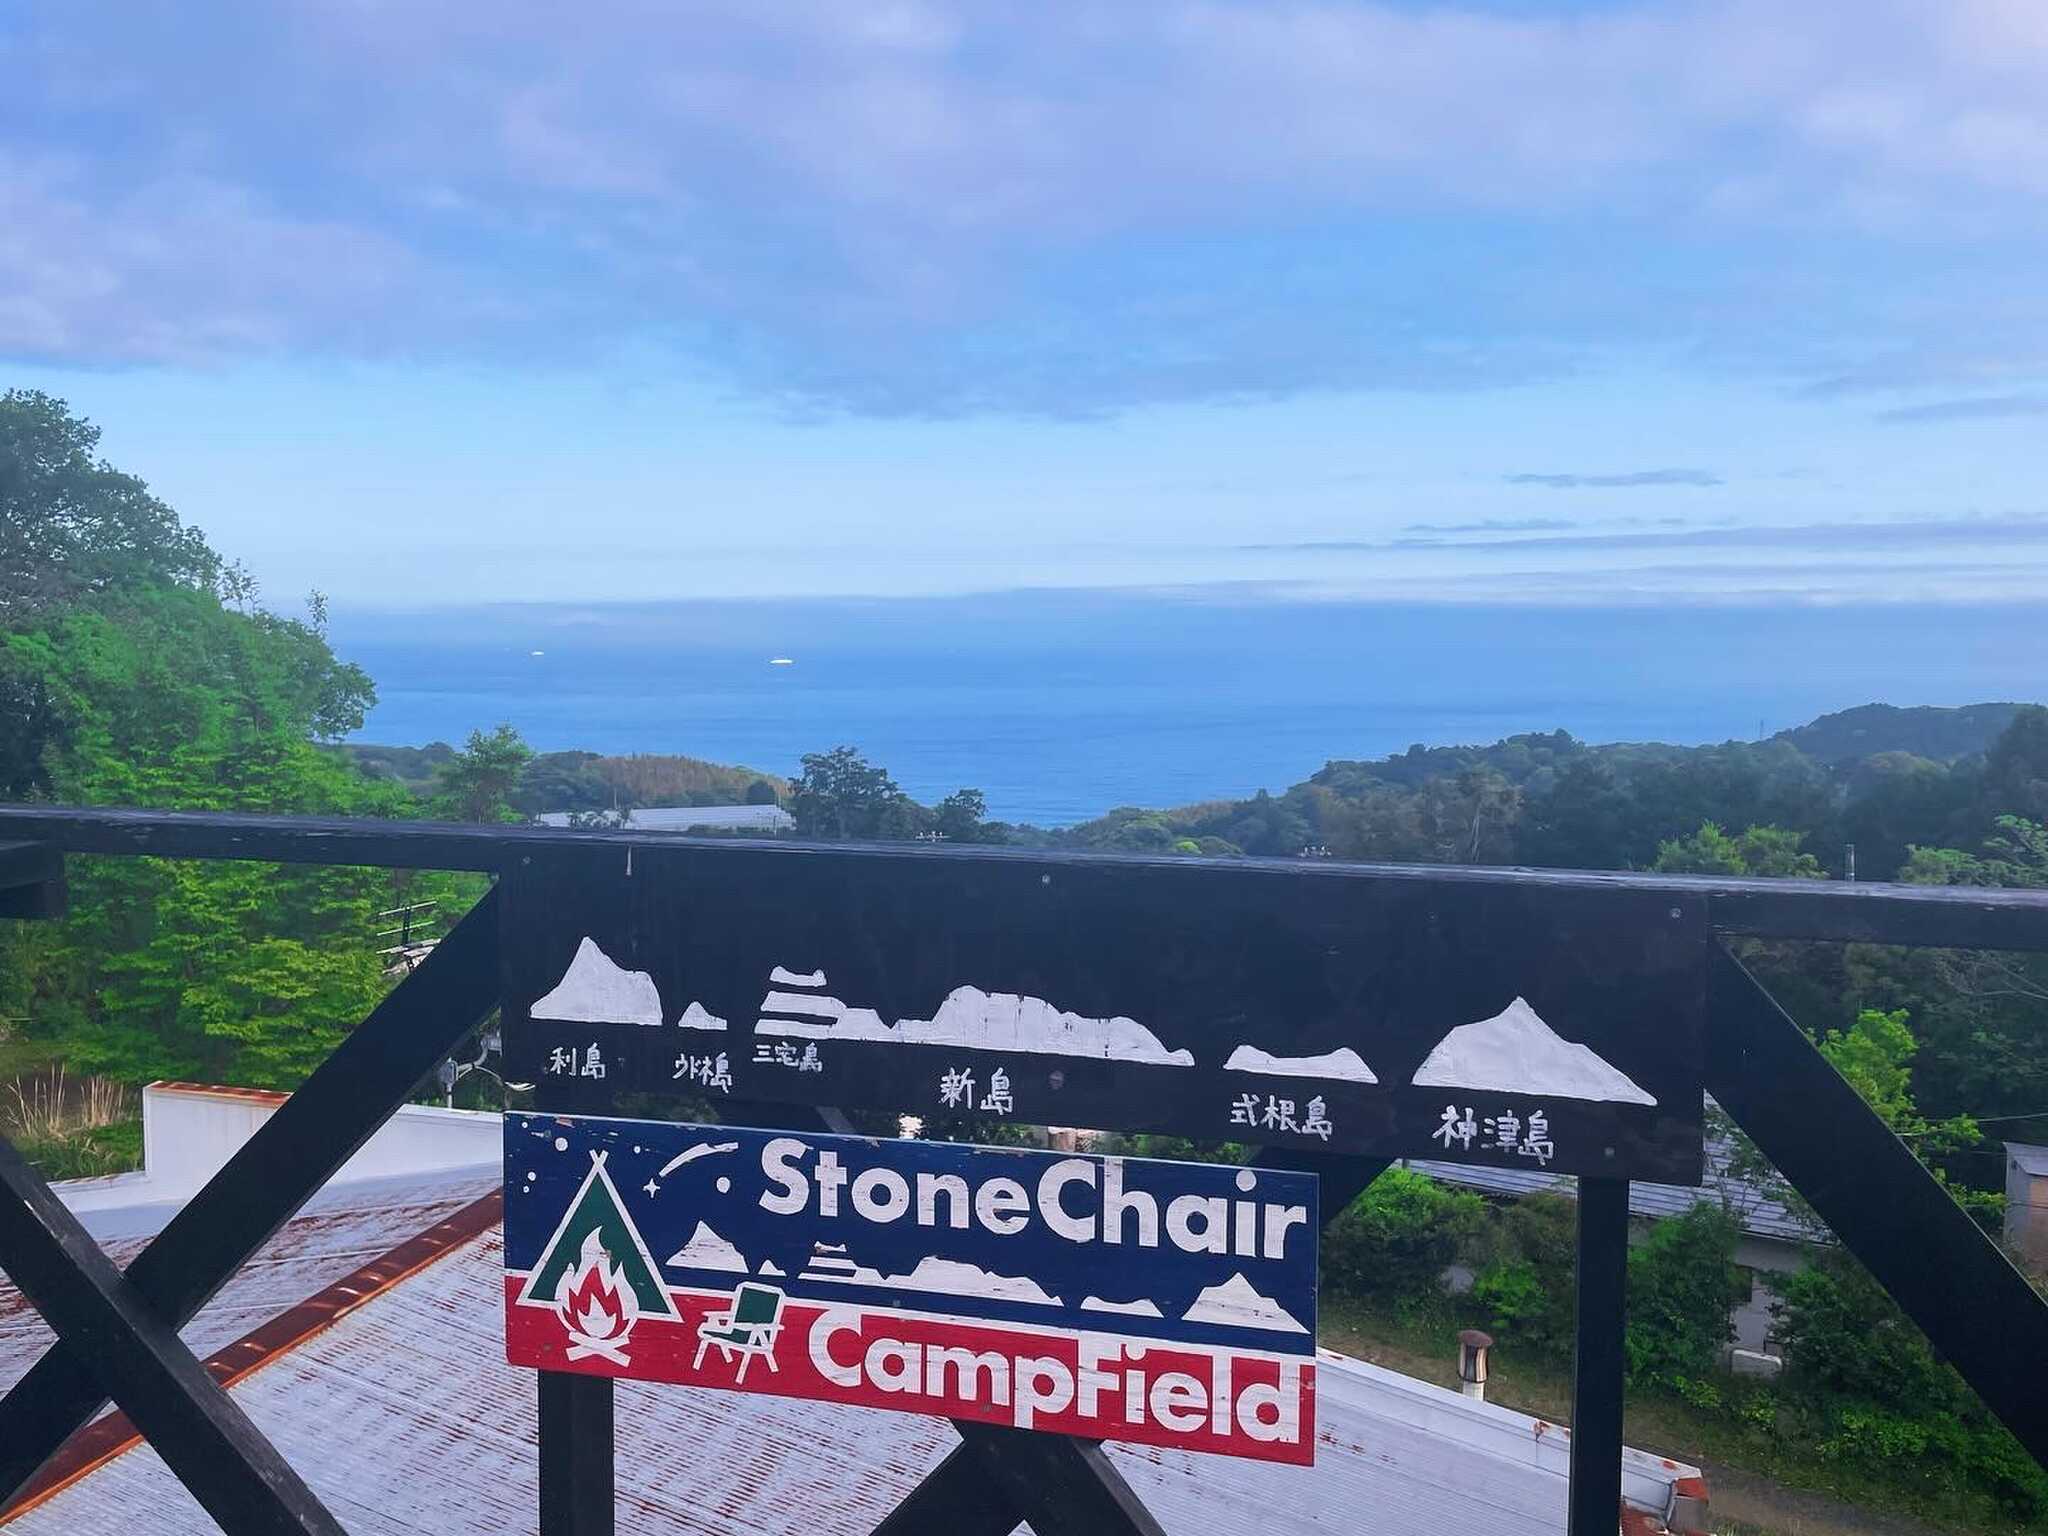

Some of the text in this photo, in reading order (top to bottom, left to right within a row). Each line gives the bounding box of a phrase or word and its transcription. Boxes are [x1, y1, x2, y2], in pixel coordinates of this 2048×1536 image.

[549, 1042, 606, 1080] 利島
[752, 1041, 823, 1072] 三宅島
[939, 1067, 1013, 1115] 新島
[1230, 1094, 1332, 1141] 式根島
[1432, 1105, 1554, 1165] 神津島
[758, 1137, 1308, 1260] StoneChair
[809, 1308, 1301, 1445] CampField
